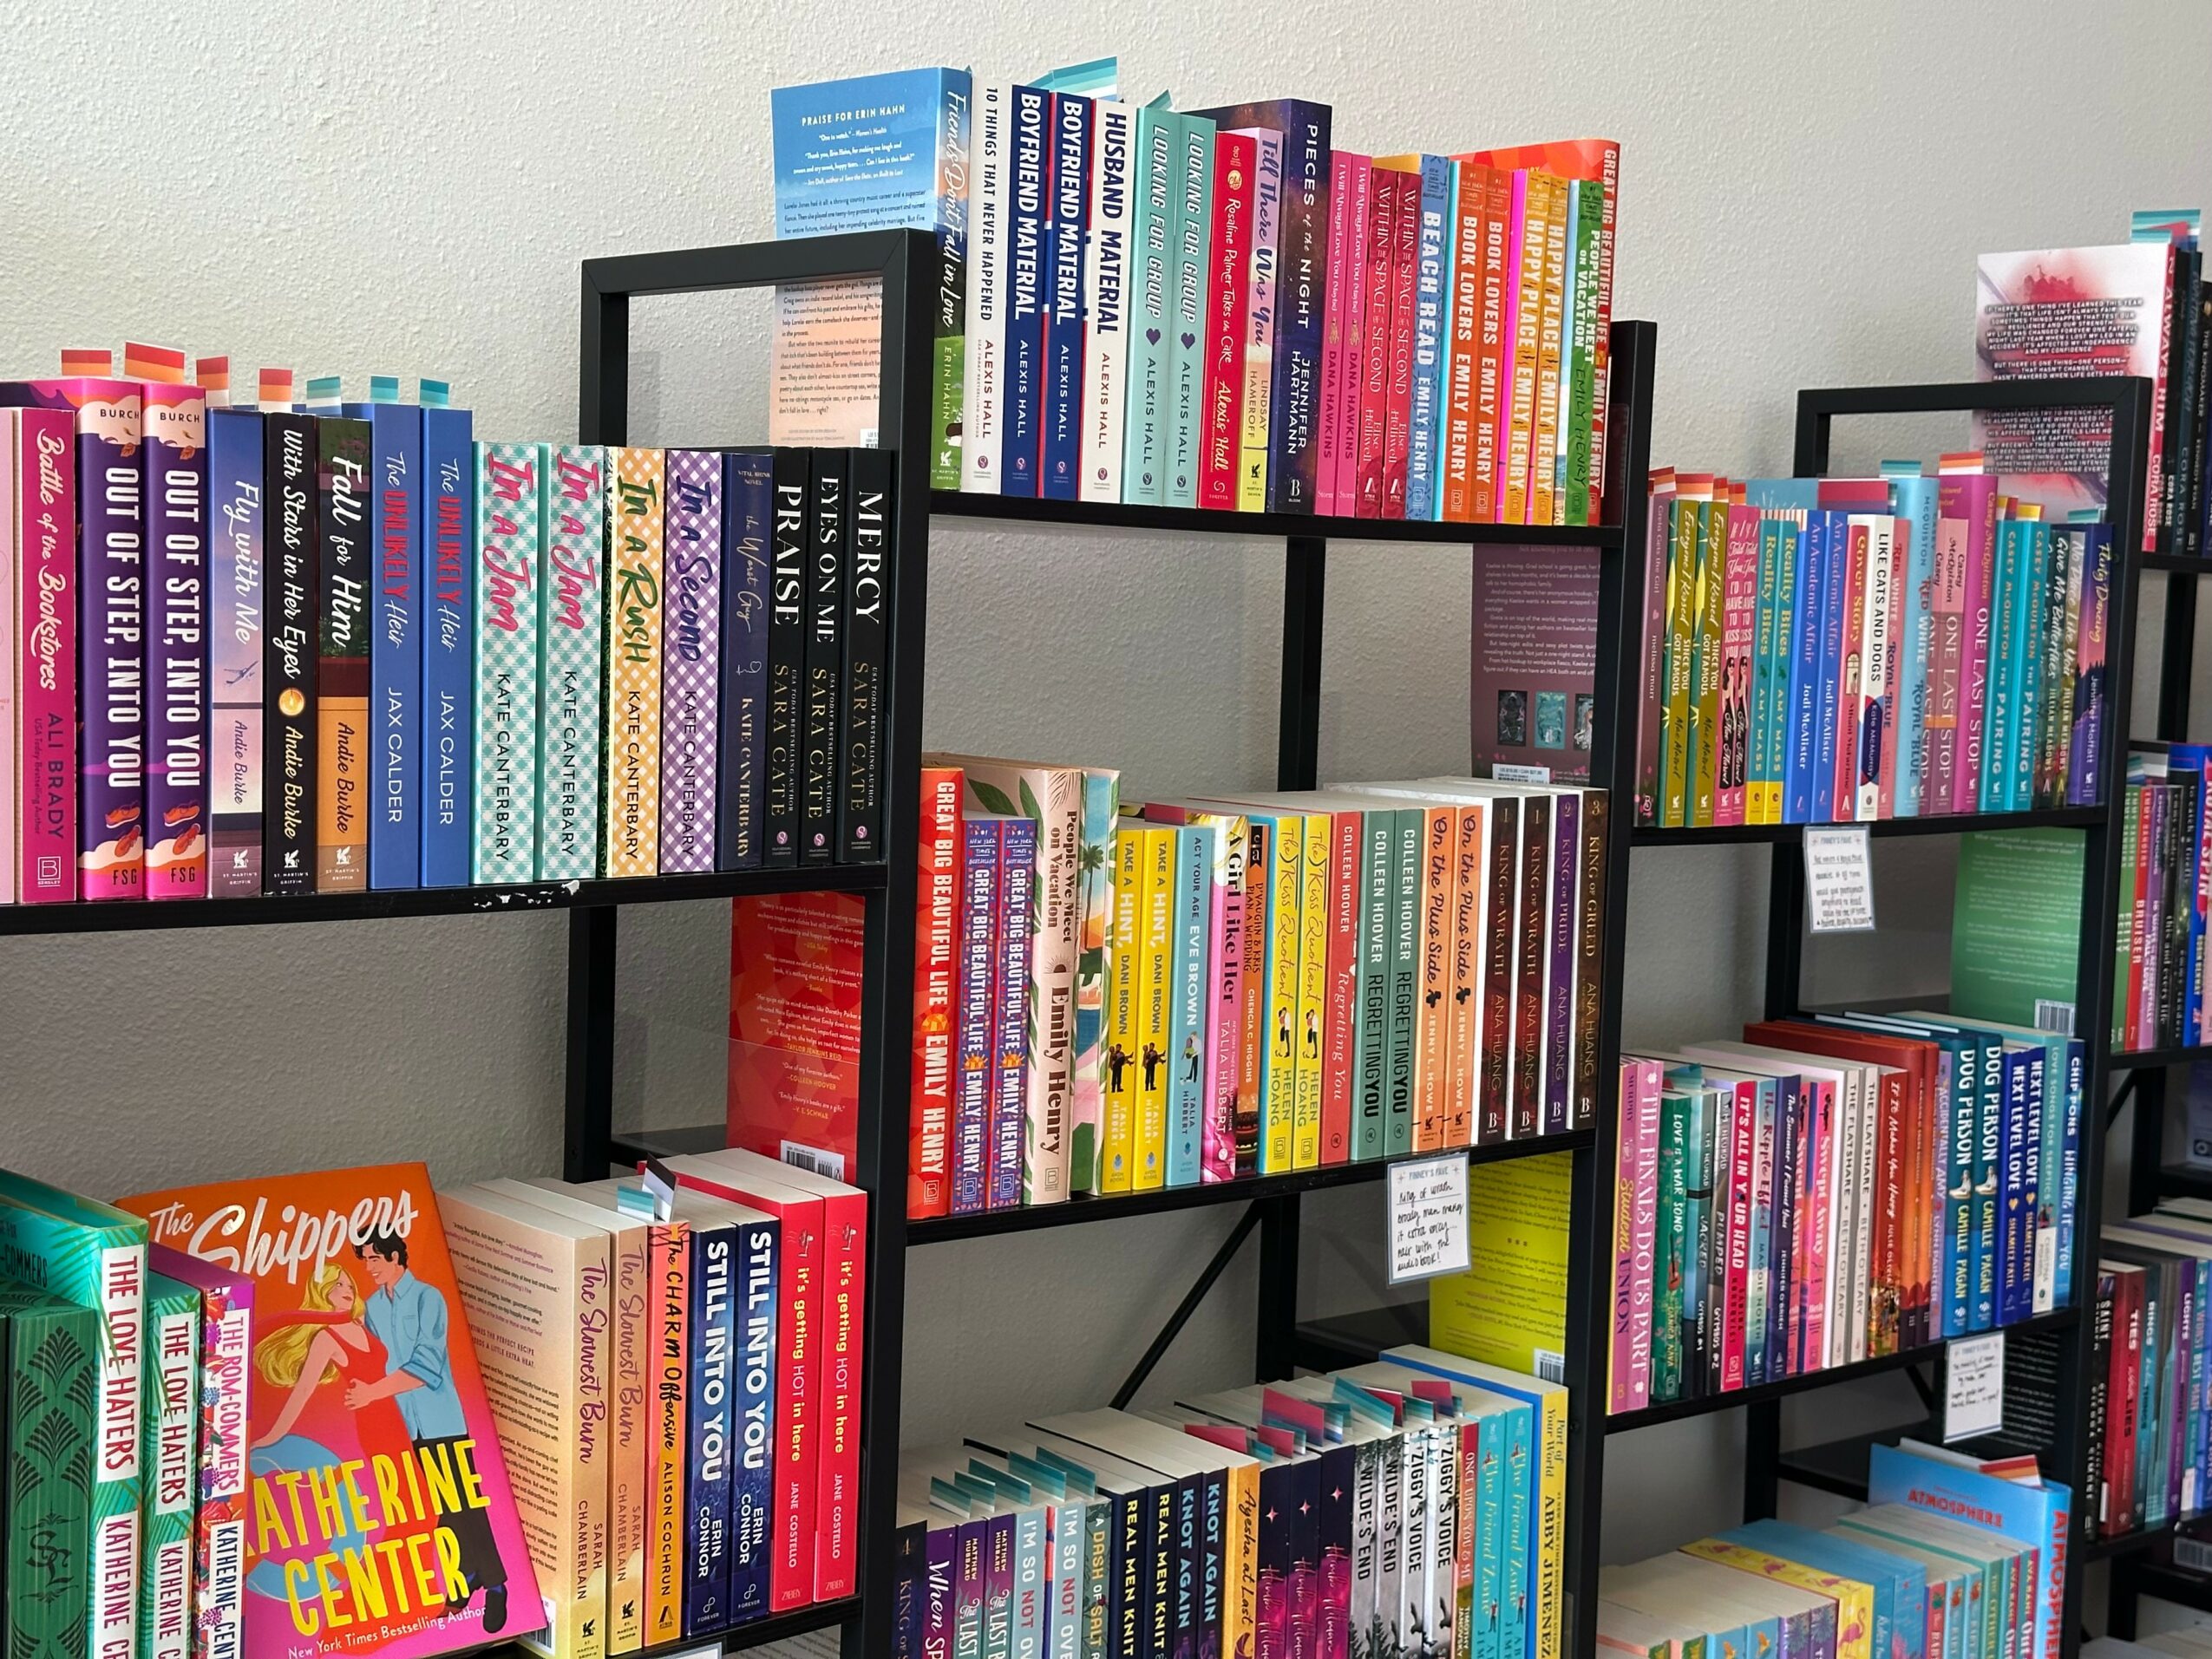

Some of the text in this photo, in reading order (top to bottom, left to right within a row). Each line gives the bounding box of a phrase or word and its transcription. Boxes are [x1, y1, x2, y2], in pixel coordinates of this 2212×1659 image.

[802, 104, 906, 126] PRAISE FOR ERIN HAHN
[980, 88, 998, 320] 10 THINGS THAT NEVER HAPPENED
[1097, 113, 1127, 335] HUSBAND MATERIAL
[1298, 124, 1317, 330] PIECES of the NIGHT
[1416, 211, 1442, 366] BEACH READ
[1287, 350, 1301, 455] HARTMANN
[1298, 358, 1311, 447] JENNIFER
[1323, 350, 1337, 458] DANA HAWKINS
[2154, 286, 2174, 431] ALWAYS HIM
[160, 412, 200, 423] BURCH
[2146, 454, 2162, 536] CORA ROSE
[30, 428, 66, 690] Battle of the Bookstores
[330, 456, 362, 648] Fall for Him
[817, 477, 838, 643] EYES ON ME
[855, 491, 883, 624] MERCY
[1871, 533, 1889, 682] LIKE CATS AND DOGS
[106, 468, 141, 787] OUT OF STEP, INTO YOU
[1671, 633, 1682, 696] GOT FAMOUS
[1681, 639, 1690, 669] SINCE
[1939, 617, 1957, 778] ONE LAST STOP
[1993, 694, 2006, 774] PAIRING
[47, 713, 63, 839] ALI BRADY
[495, 673, 510, 860] KATE CANTERBARY
[113, 868, 137, 886] FSG
[928, 782, 955, 1006] GREAT BIG BEAUTIFUL LIFE
[1117, 841, 1133, 948] TAKE A HINT,
[2198, 845, 2210, 895] SPIN
[1392, 829, 1416, 1113] COLLEEN HOOVER REGRETTINGYOU
[2132, 899, 2145, 963] BRUISER
[1039, 987, 1069, 1154] Emily Henry
[1216, 1020, 1229, 1133] TALIA HIBBERT
[1424, 1073, 1434, 1112] HOWE
[1428, 1059, 1435, 1070] L.
[1956, 1049, 1975, 1166] DOG PERSON
[1843, 1081, 1856, 1199] THE FLATSHARE
[2009, 1065, 2025, 1192] NEXT LEVEL LOVE
[149, 1201, 194, 1244] The
[187, 1190, 418, 1285] Shippers
[1416, 1241, 1431, 1254] with
[1437, 1238, 1450, 1249] the
[1420, 1187, 1426, 1199] of
[1618, 1257, 1629, 1336] UNION
[1755, 1244, 1766, 1340] MAGGIE NORTH
[1956, 1205, 1969, 1299] CAMILLE PAGAN
[105, 1256, 138, 1471] THE LOVE HATERS
[702, 1241, 729, 1481] STILL INTO YOU
[2183, 1292, 2192, 1340] LIGHTS
[661, 1462, 673, 1596] ALISON COCHRUN
[789, 1481, 799, 1569] JANE COSTELLO
[1178, 1489, 1194, 1629] KNOT AGAIN
[1409, 1452, 1424, 1574] ZIGGY'S VOICE
[1908, 1489, 2002, 1527] ATMOSPHERE
[285, 1526, 470, 1637] CENTER
[288, 1605, 488, 1659] New York Times Bestselling Author
[697, 1612, 720, 1623] FOREVER
[782, 1589, 802, 1600] ZIBBY
[1122, 1499, 1137, 1655] REAL MEN KNIT
[1541, 1495, 1554, 1659] ABBY JIMENEZ
